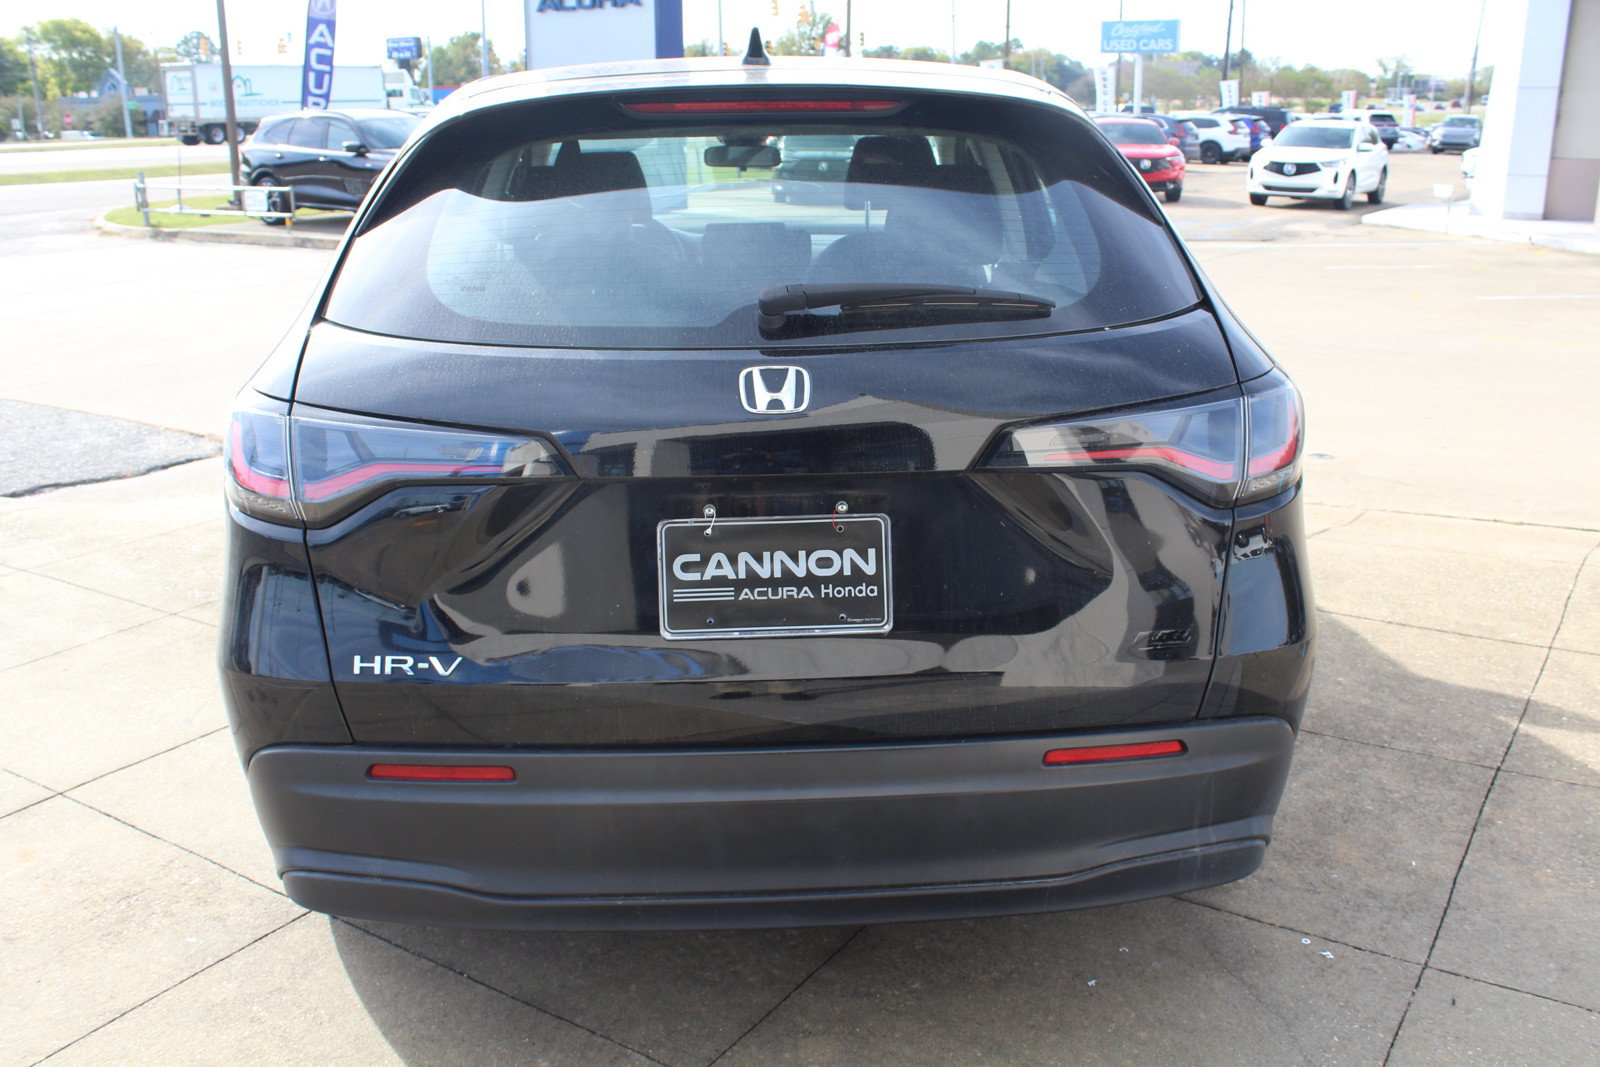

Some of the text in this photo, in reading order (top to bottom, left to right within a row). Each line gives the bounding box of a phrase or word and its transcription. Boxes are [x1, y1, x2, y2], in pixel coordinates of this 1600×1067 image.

[1103, 38, 1174, 51] USED CARS
[672, 548, 876, 581] CANNON
[738, 583, 878, 601] ACURA Honda
[353, 655, 463, 677] HR-V
